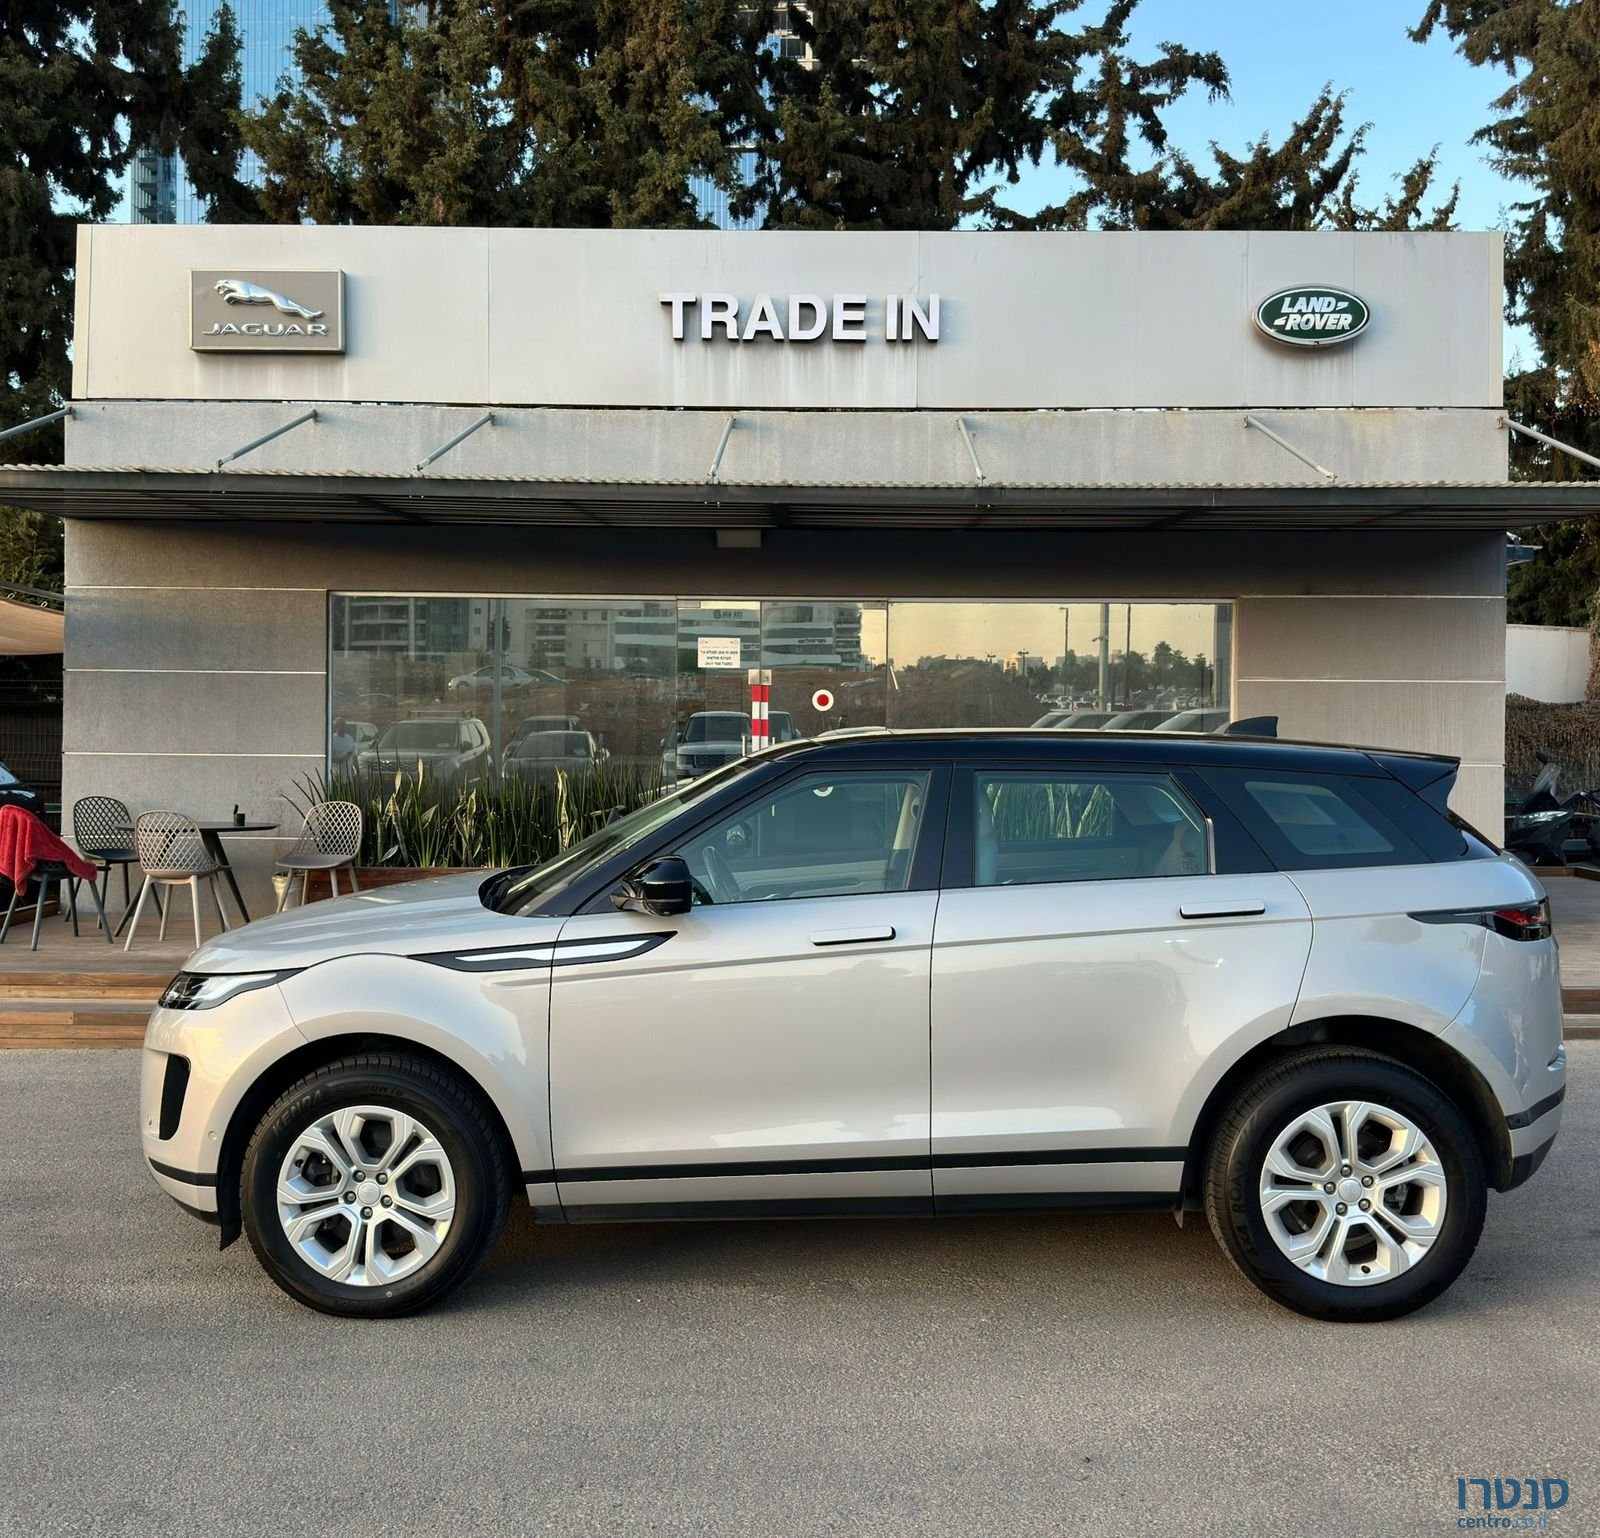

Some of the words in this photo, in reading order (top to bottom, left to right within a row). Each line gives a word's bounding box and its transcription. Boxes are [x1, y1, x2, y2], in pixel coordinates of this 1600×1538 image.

[1281, 297, 1337, 313] LAND
[659, 293, 867, 341] TRADE
[886, 293, 940, 341] IN
[1285, 313, 1353, 330] ROVER
[202, 323, 329, 337] JAGUAR
